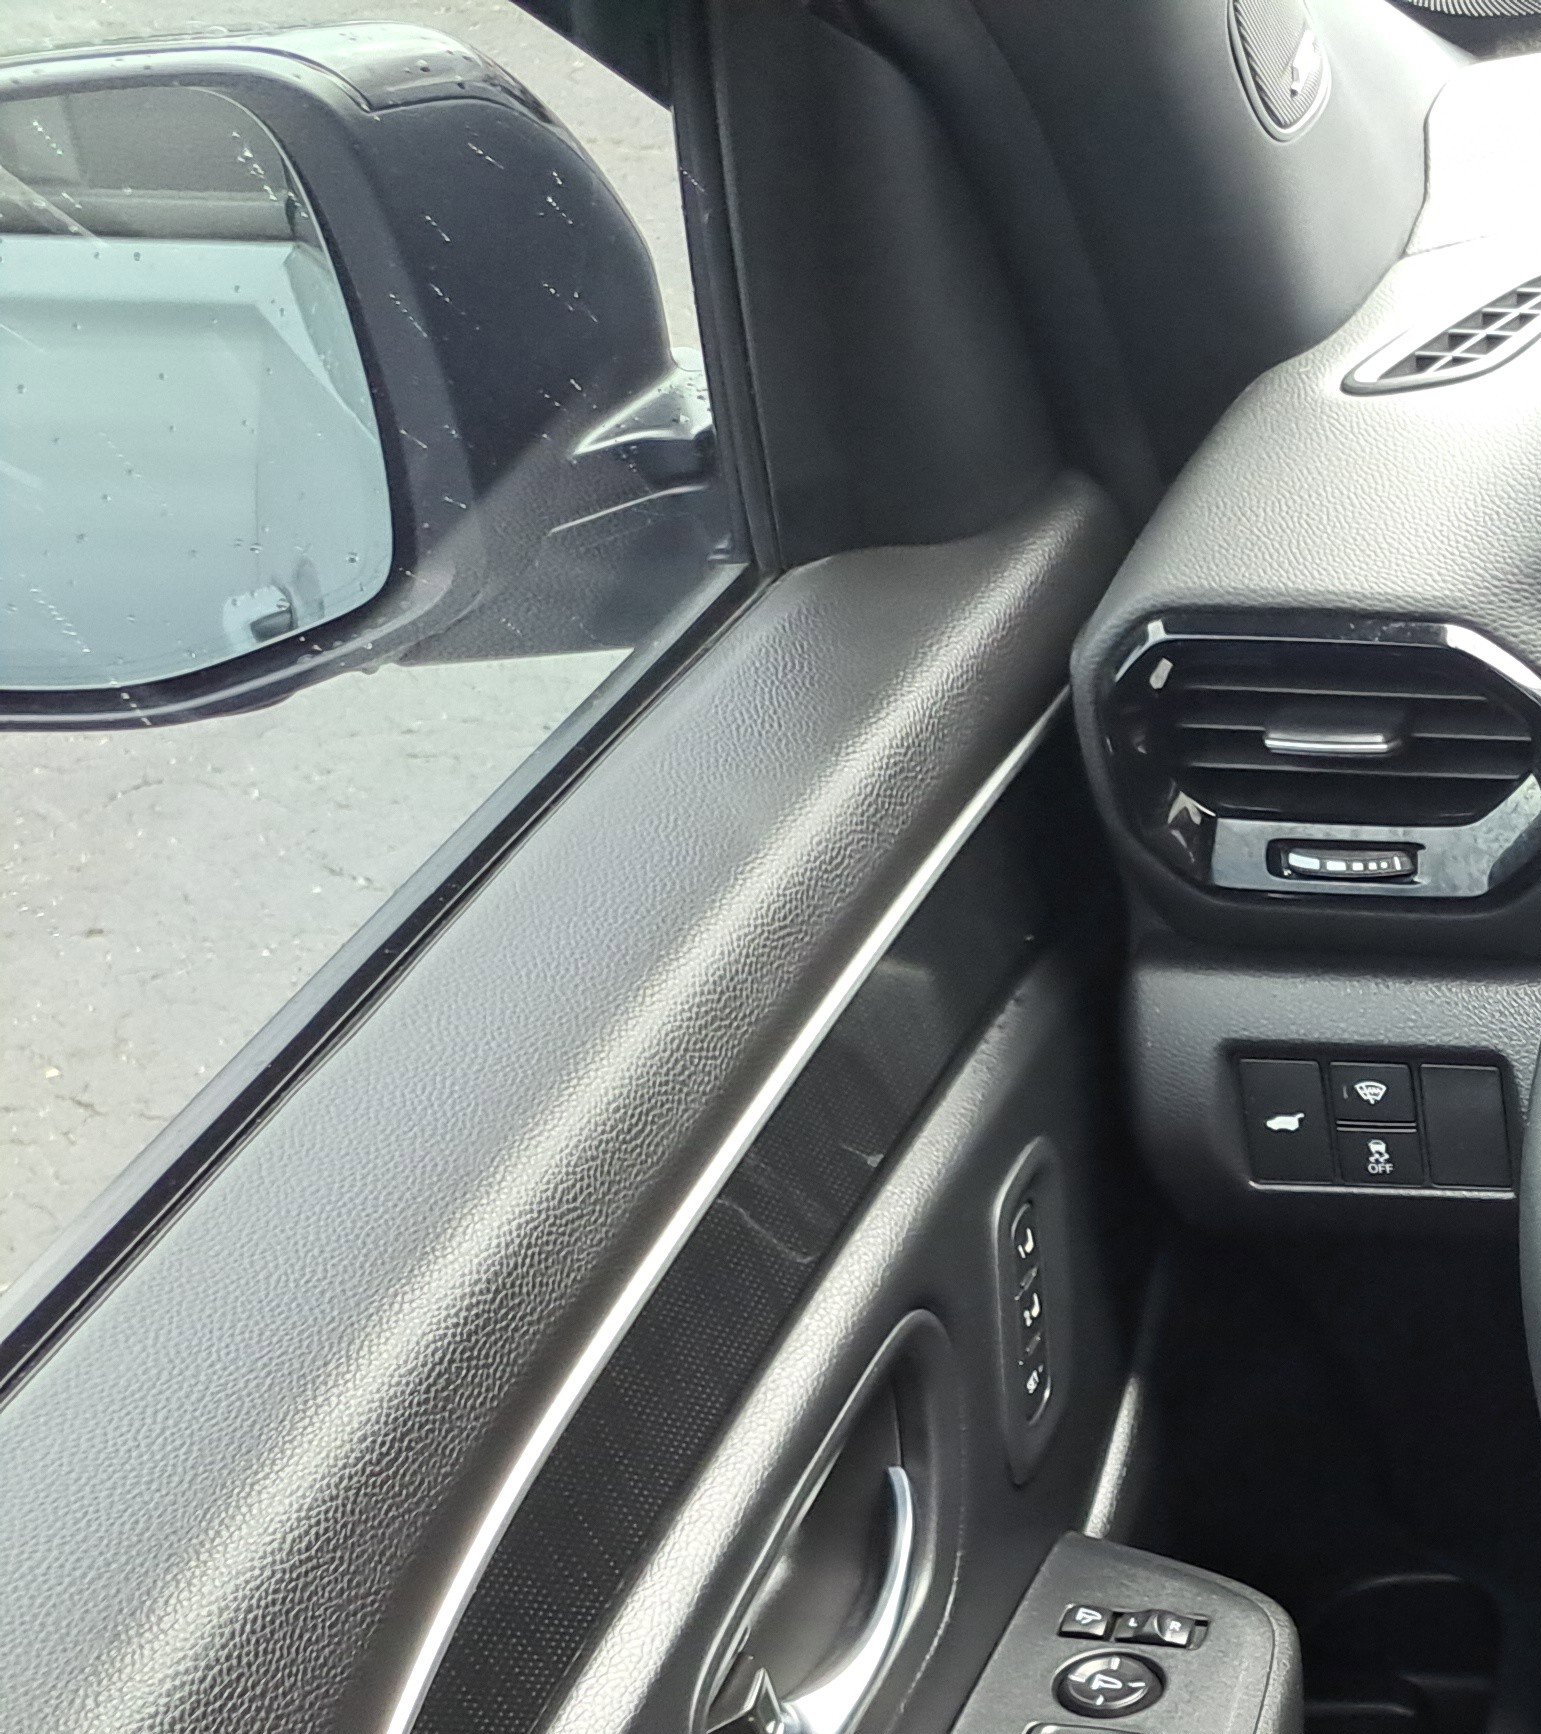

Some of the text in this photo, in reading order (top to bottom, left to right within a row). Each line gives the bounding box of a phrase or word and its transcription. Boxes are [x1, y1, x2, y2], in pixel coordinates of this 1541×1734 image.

[1367, 1163, 1394, 1174] OFF
[1128, 1617, 1138, 1627] L
[1169, 1620, 1182, 1631] R
